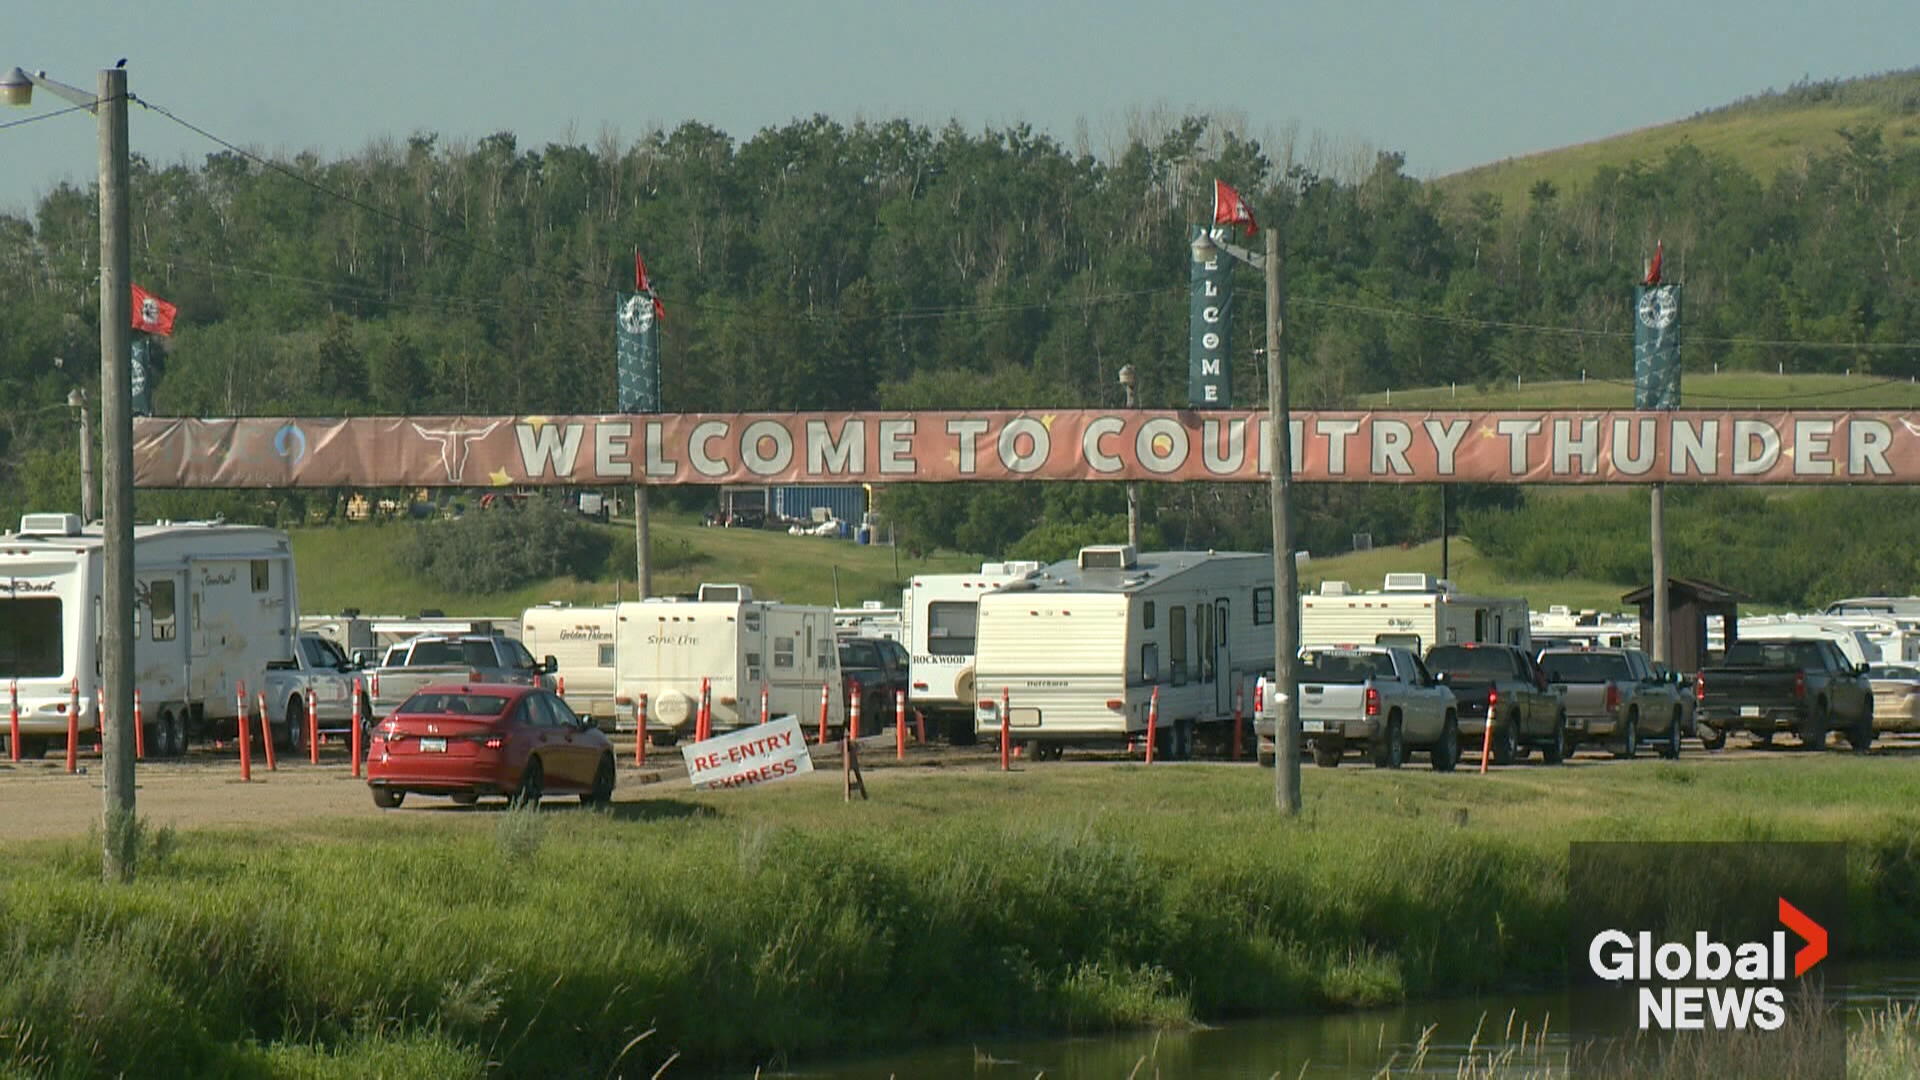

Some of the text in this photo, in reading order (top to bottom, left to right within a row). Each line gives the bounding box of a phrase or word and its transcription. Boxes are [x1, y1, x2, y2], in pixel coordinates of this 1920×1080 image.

[514, 419, 918, 477] WELCOME
[946, 417, 1050, 474] TO
[1497, 417, 1895, 476] THUNDER
[913, 655, 966, 664] ROCKWOOD
[694, 730, 792, 772] RE-ENTRY
